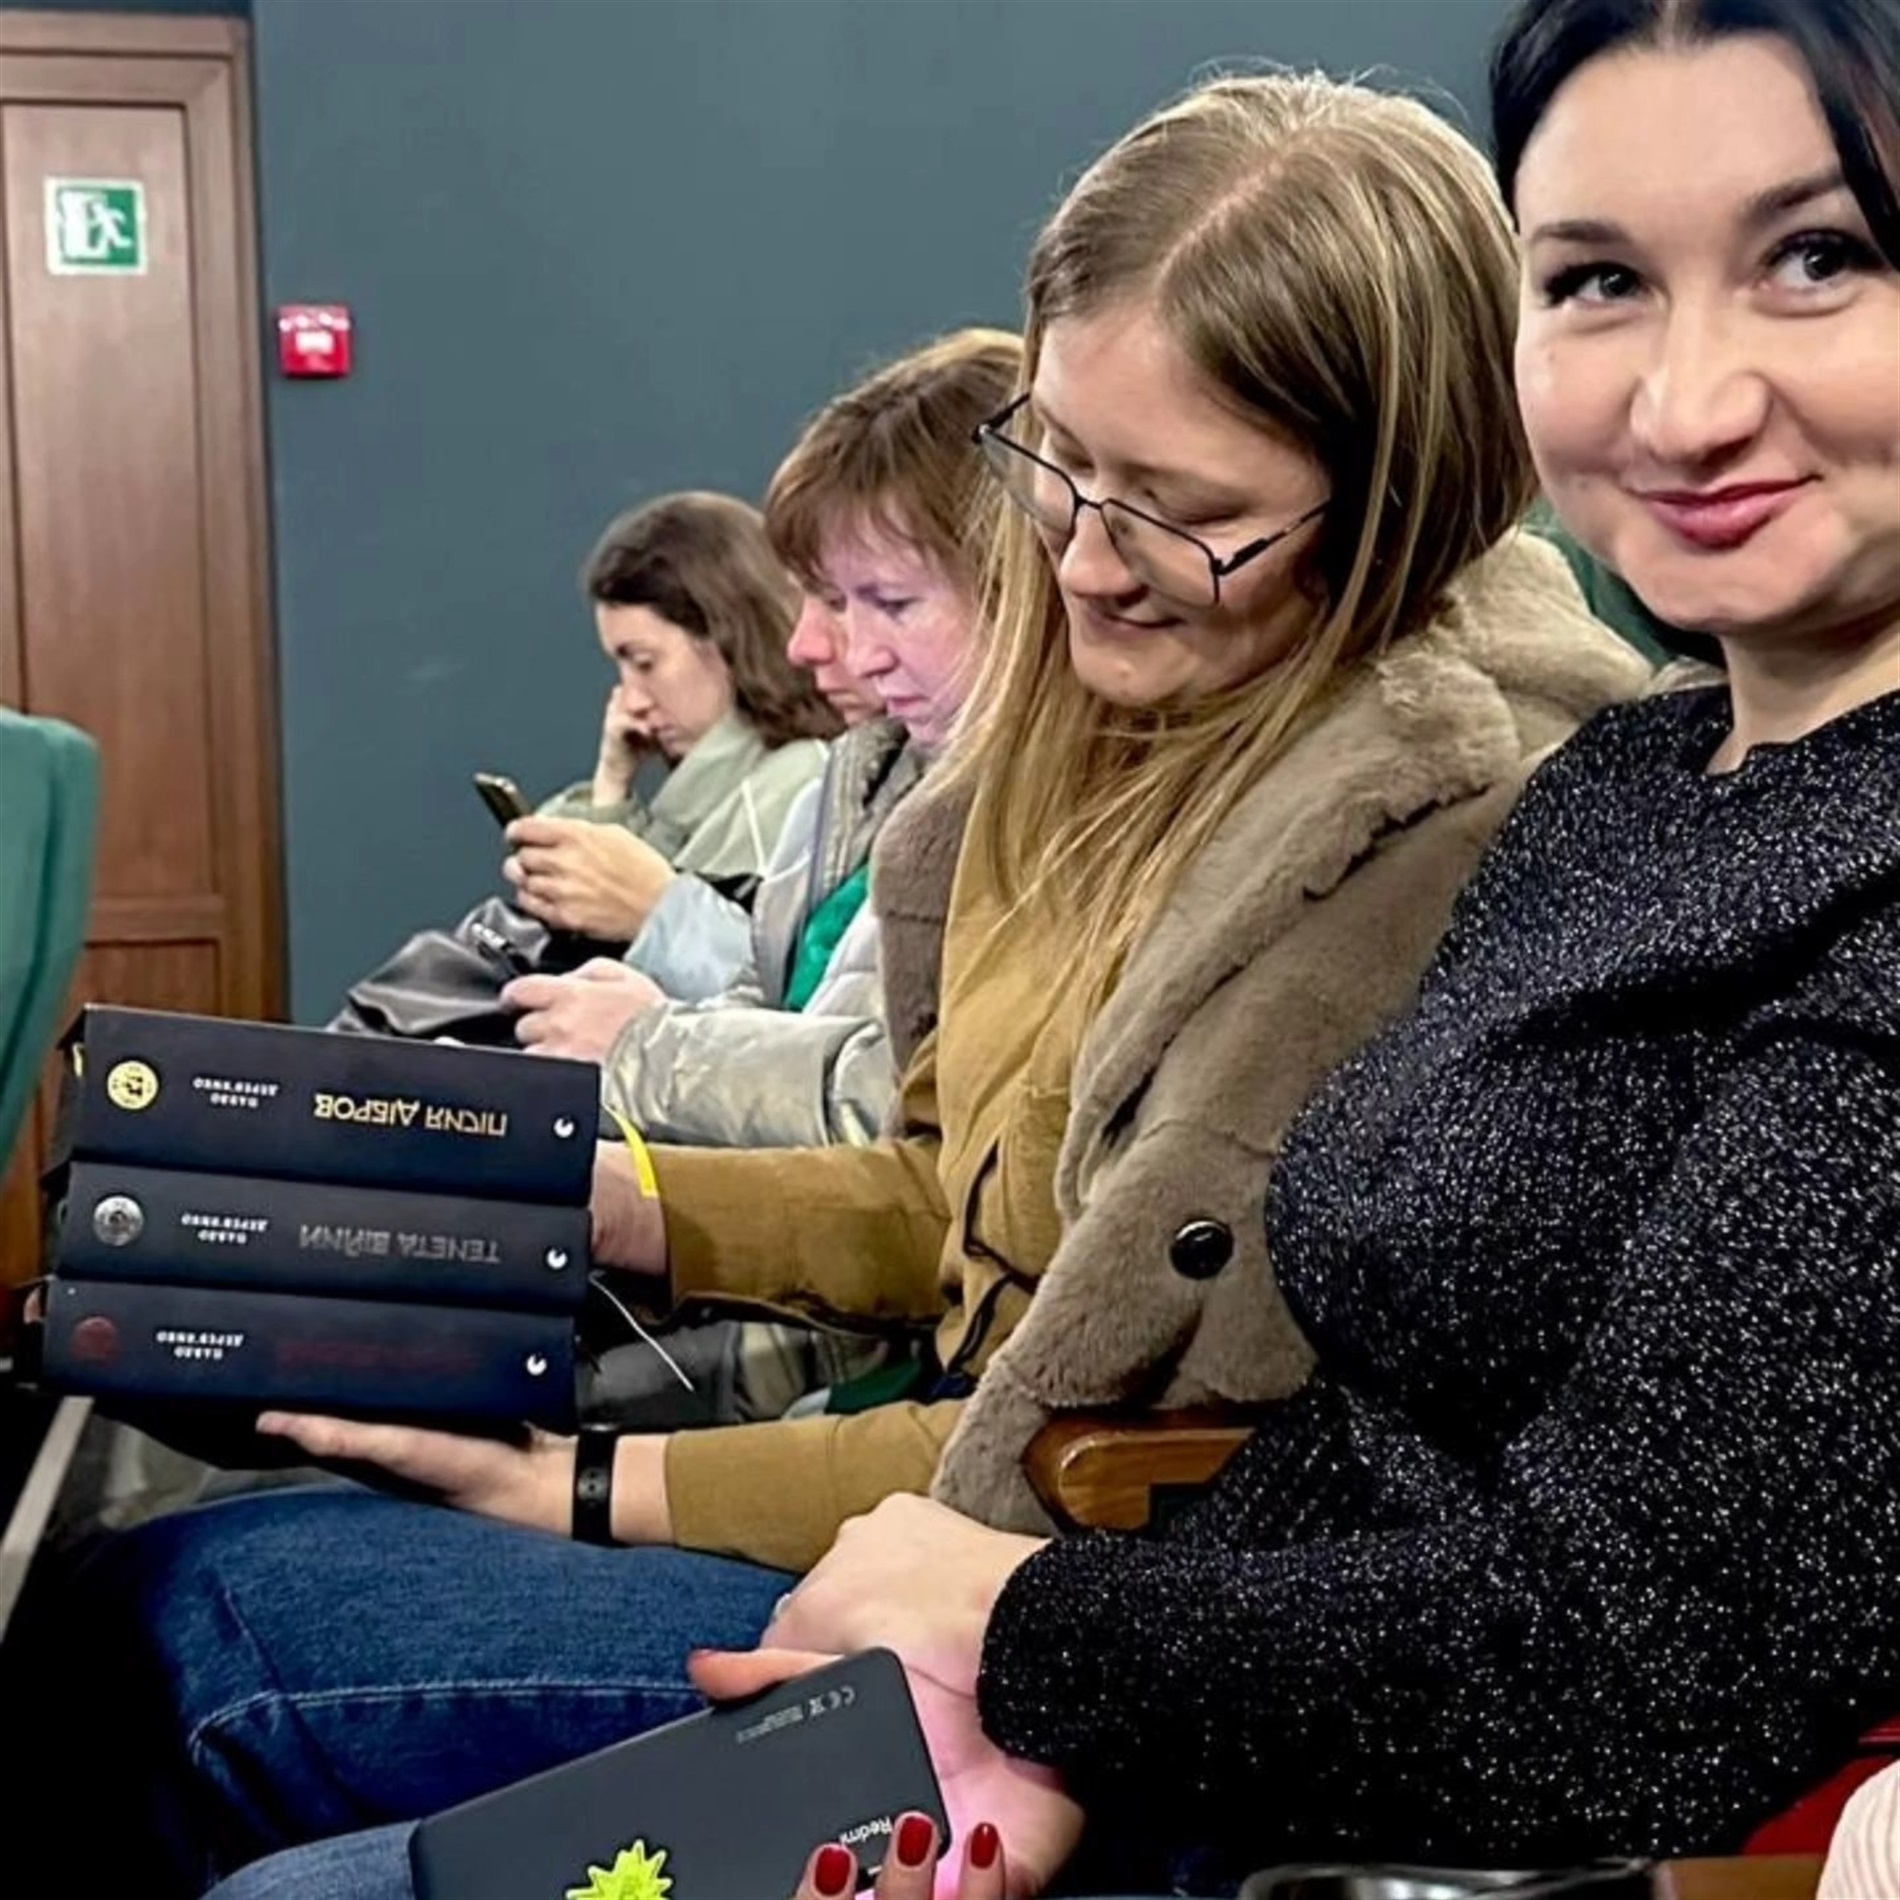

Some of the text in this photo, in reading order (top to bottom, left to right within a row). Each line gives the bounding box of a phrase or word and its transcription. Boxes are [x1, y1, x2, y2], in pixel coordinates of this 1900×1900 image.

[314, 1093, 508, 1137] ПІСНЯ ДІБРОВ
[301, 1224, 500, 1263] ТЕНЕТА ВІЙНИ
[839, 1816, 893, 1845] Redmi
